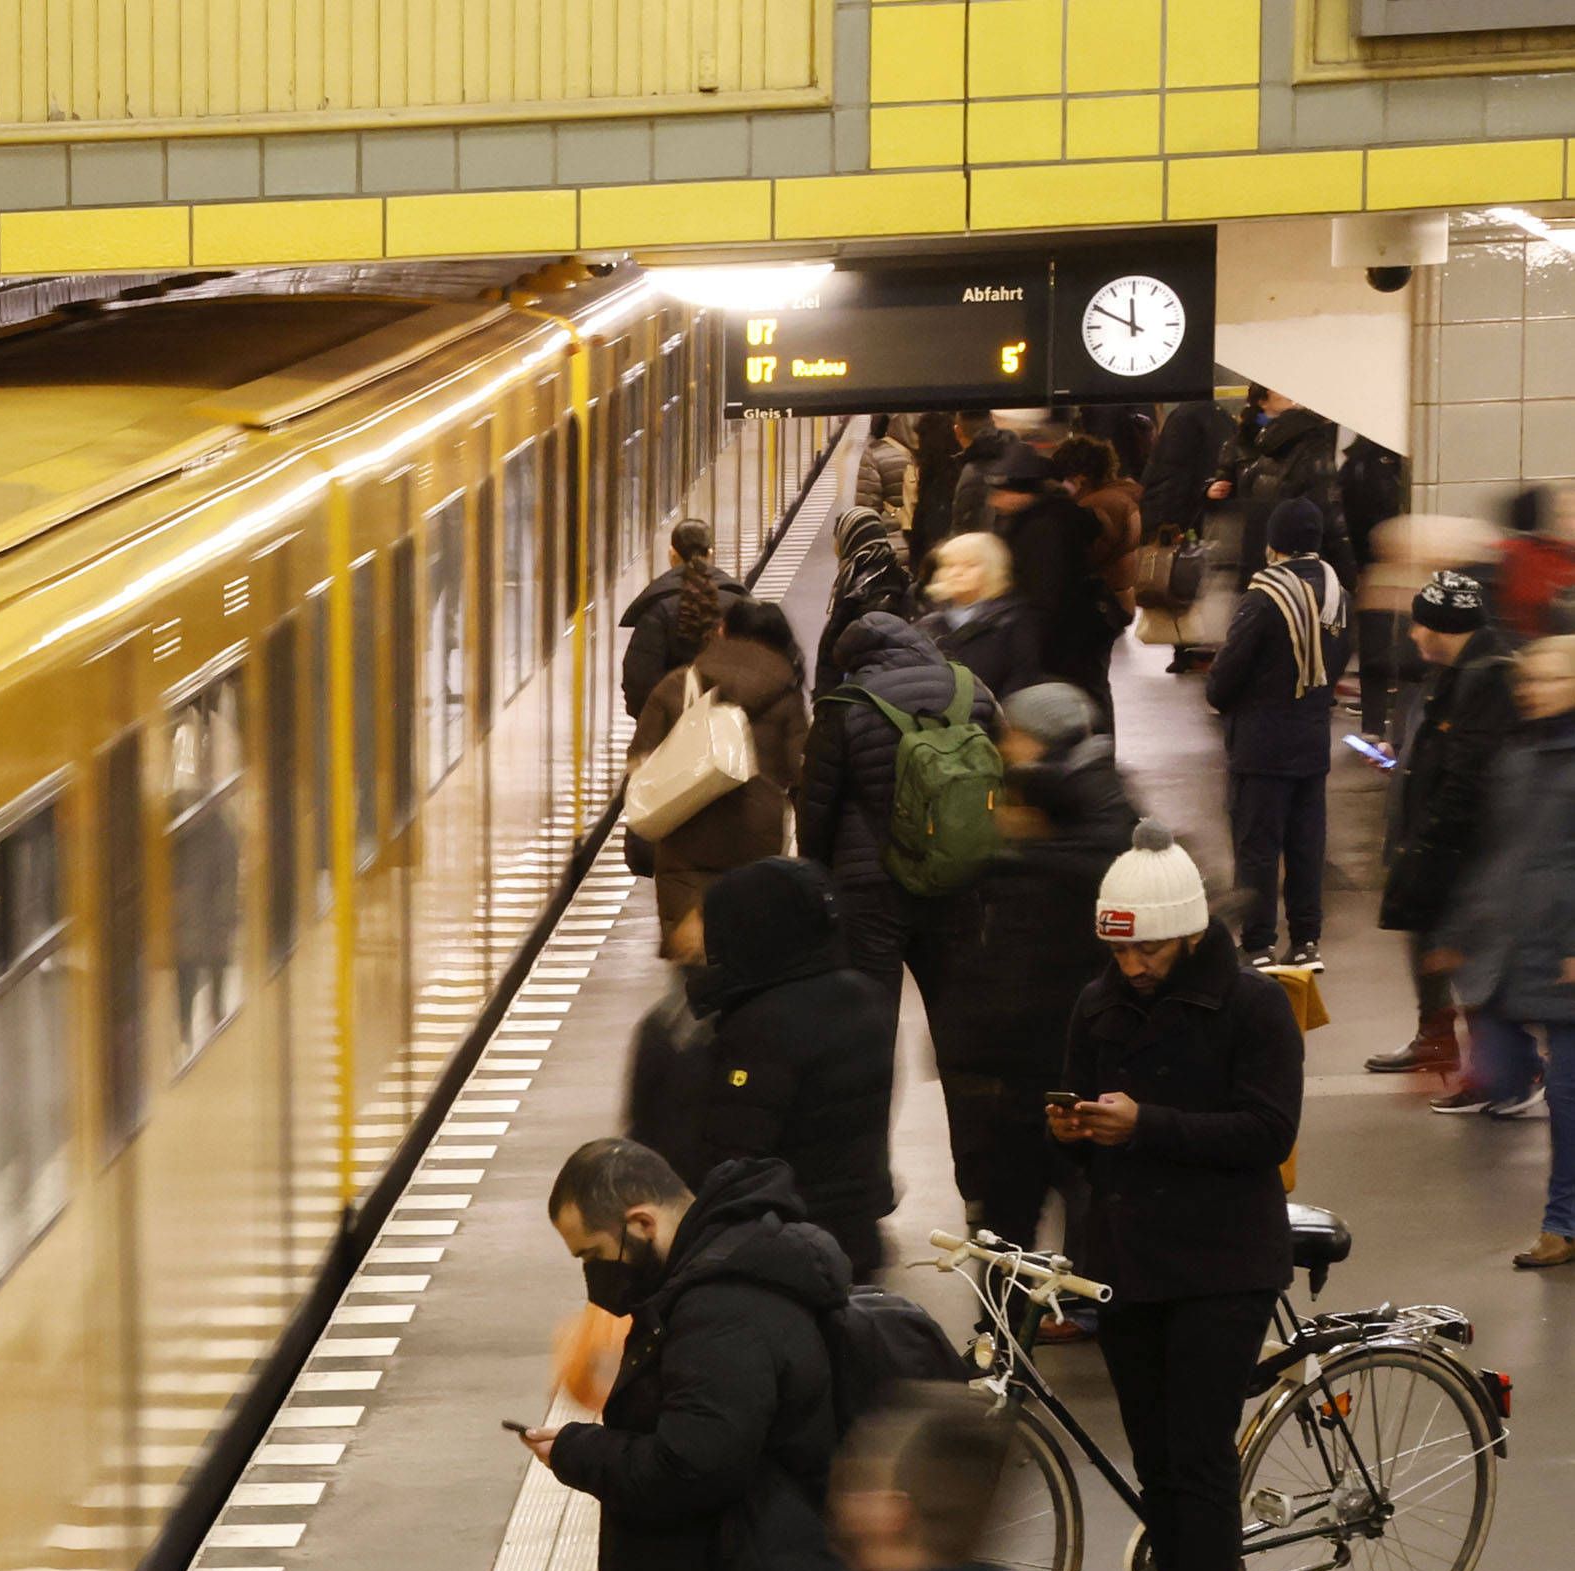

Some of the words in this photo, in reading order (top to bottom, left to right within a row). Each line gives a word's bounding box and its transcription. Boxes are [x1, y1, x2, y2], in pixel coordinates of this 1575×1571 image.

[962, 286, 1024, 303] Abfahrt
[746, 318, 777, 346] U7
[746, 356, 777, 383] U7
[791, 359, 847, 377] Rudow
[743, 408, 781, 419] Gleis
[785, 408, 793, 418] 1
